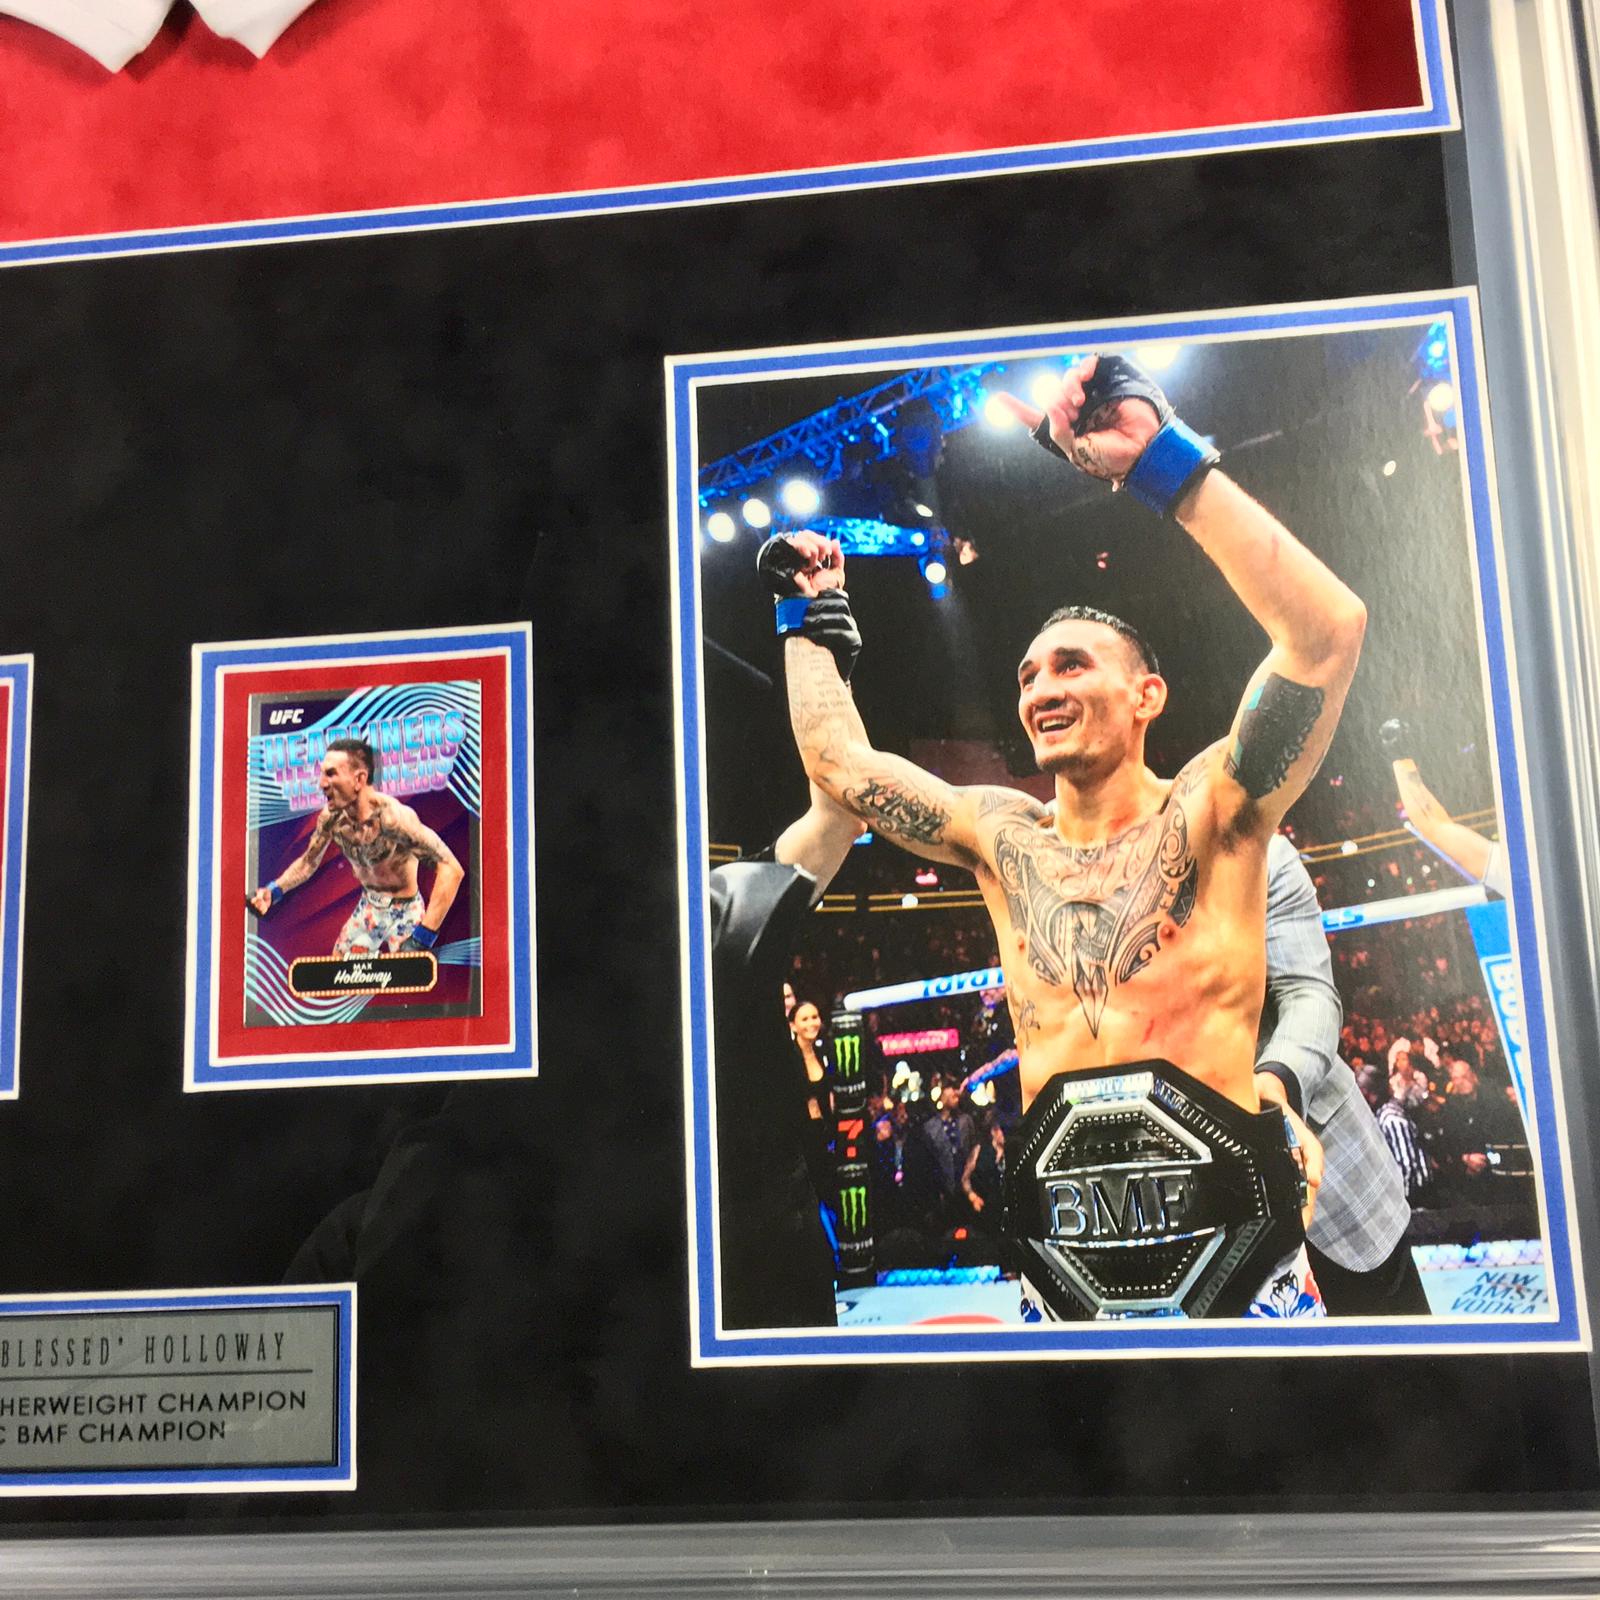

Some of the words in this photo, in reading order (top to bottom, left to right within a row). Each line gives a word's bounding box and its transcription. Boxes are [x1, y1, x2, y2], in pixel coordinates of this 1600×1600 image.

[269, 708, 305, 726] UFC
[353, 962, 373, 971] MAX
[333, 968, 393, 989] Holloway
[1045, 1168, 1194, 1236] BMF
[1463, 1284, 1548, 1303] AMST
[145, 1331, 284, 1364] HOLLOWAY
[158, 1390, 306, 1414] CHAMPION
[17, 1423, 68, 1444] BMF
[78, 1420, 225, 1444] CHAMPION
